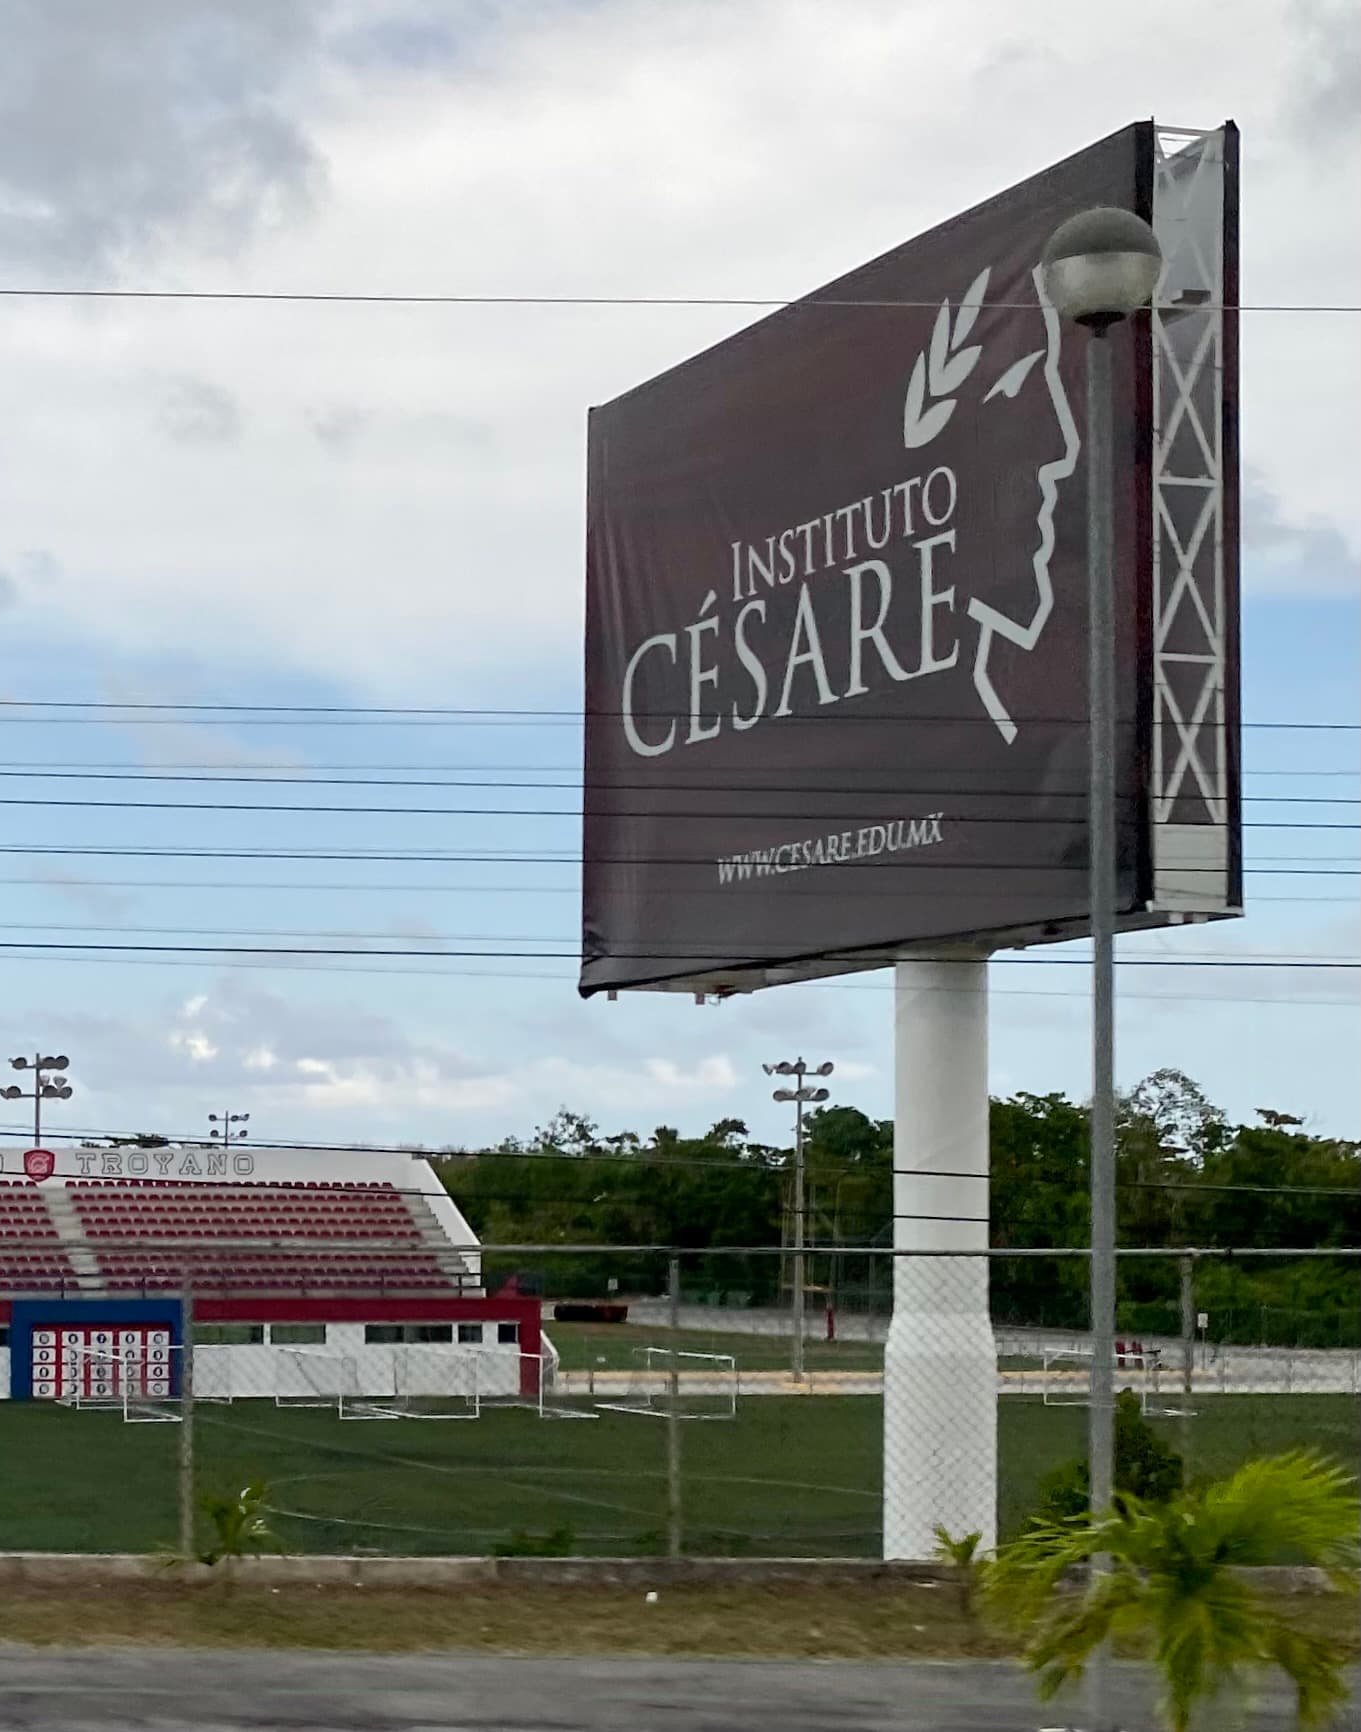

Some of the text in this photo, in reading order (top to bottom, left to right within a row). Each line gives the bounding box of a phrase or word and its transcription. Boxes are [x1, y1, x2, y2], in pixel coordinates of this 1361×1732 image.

[731, 466, 957, 601] INSTITUTO
[622, 529, 960, 756] CÉSARE
[717, 812, 944, 885] WWW.CESARE.EDU.MX
[75, 1152, 255, 1176] TROYANO
